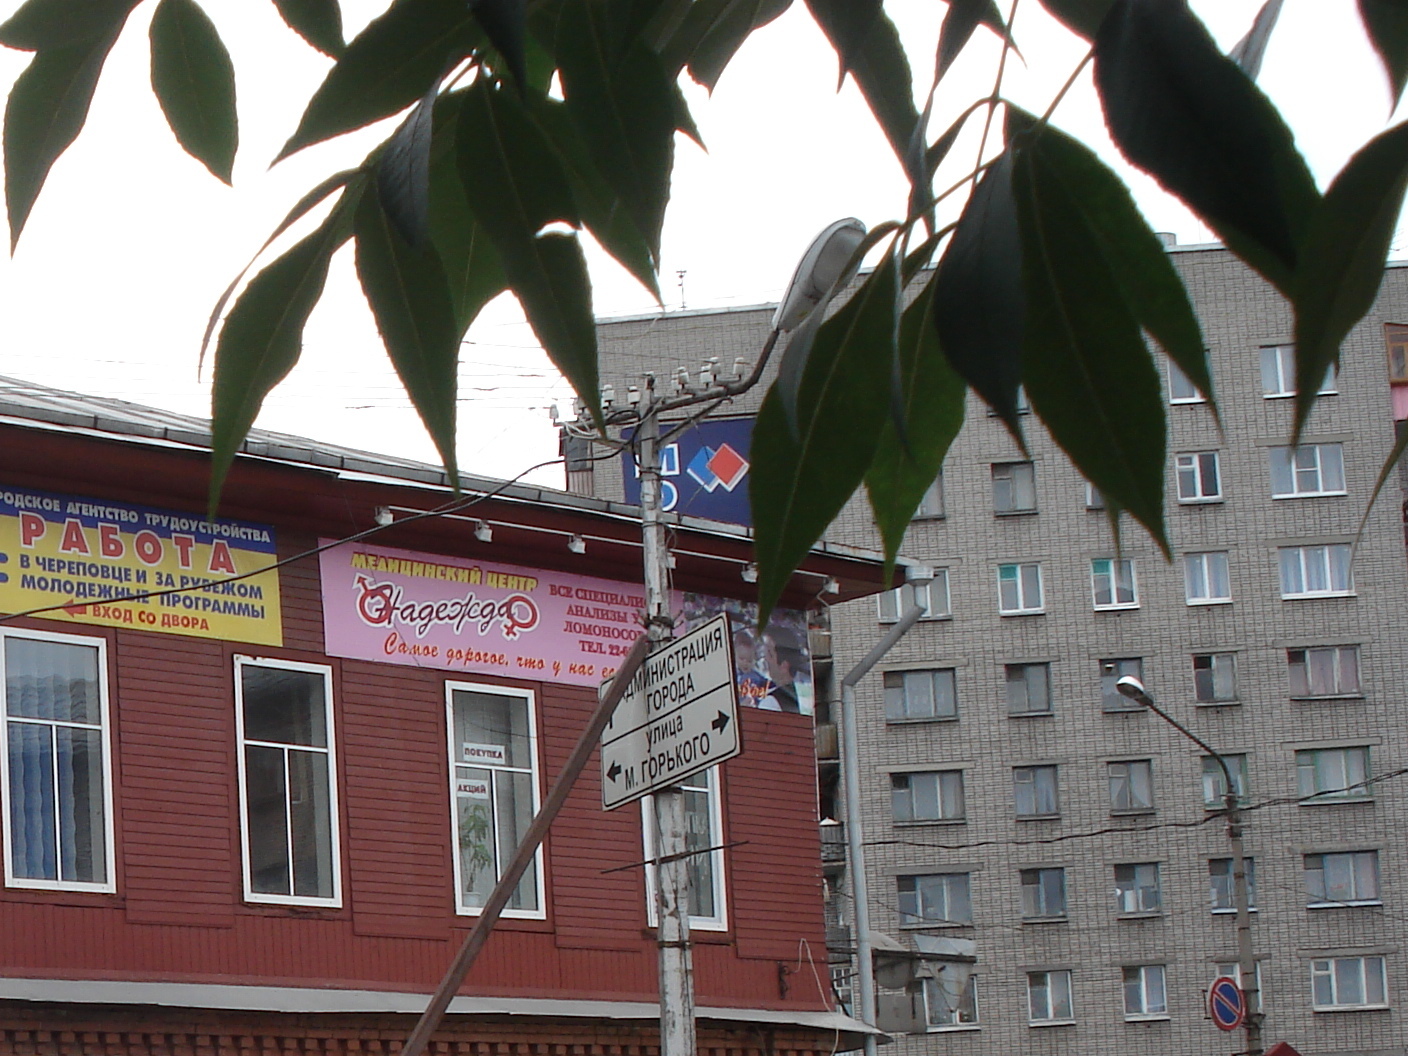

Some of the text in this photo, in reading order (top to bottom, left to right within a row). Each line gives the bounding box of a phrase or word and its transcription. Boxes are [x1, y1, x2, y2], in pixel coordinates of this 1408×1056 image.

[66, 501, 139, 524] АГЕНТСТВО
[145, 512, 271, 543] ТРУДОУСТРОЙСТВА
[19, 510, 239, 577] РАБОТА
[20, 553, 263, 600] В ЧЕРЕПОВЦЕ И ЗА РУБЕЖОМ
[350, 552, 539, 592] МЕДИЦИНСКИЙ ЦЕНТР
[549, 584, 573, 598] ВСЕ
[21, 573, 265, 619] МОЛОДЕЖНЫЕ ПРОГРАММЫ
[368, 583, 516, 638] Надежда
[567, 604, 628, 623] АНАЛИЗЫ
[92, 605, 210, 631] ВХОД СО ДВОРА
[384, 631, 439, 658] Самое
[446, 645, 510, 667] дорогое,
[516, 655, 545, 671] что
[552, 660, 562, 677] у
[569, 662, 595, 676] нас
[579, 640, 606, 655] ТЕЛ.
[646, 672, 695, 715] ГОРОДА
[464, 747, 503, 759] ПОКУПКА
[645, 714, 684, 753] улица
[624, 732, 710, 791] М. ГОРЬКОГО
[457, 783, 487, 794] АКЦИЙ
